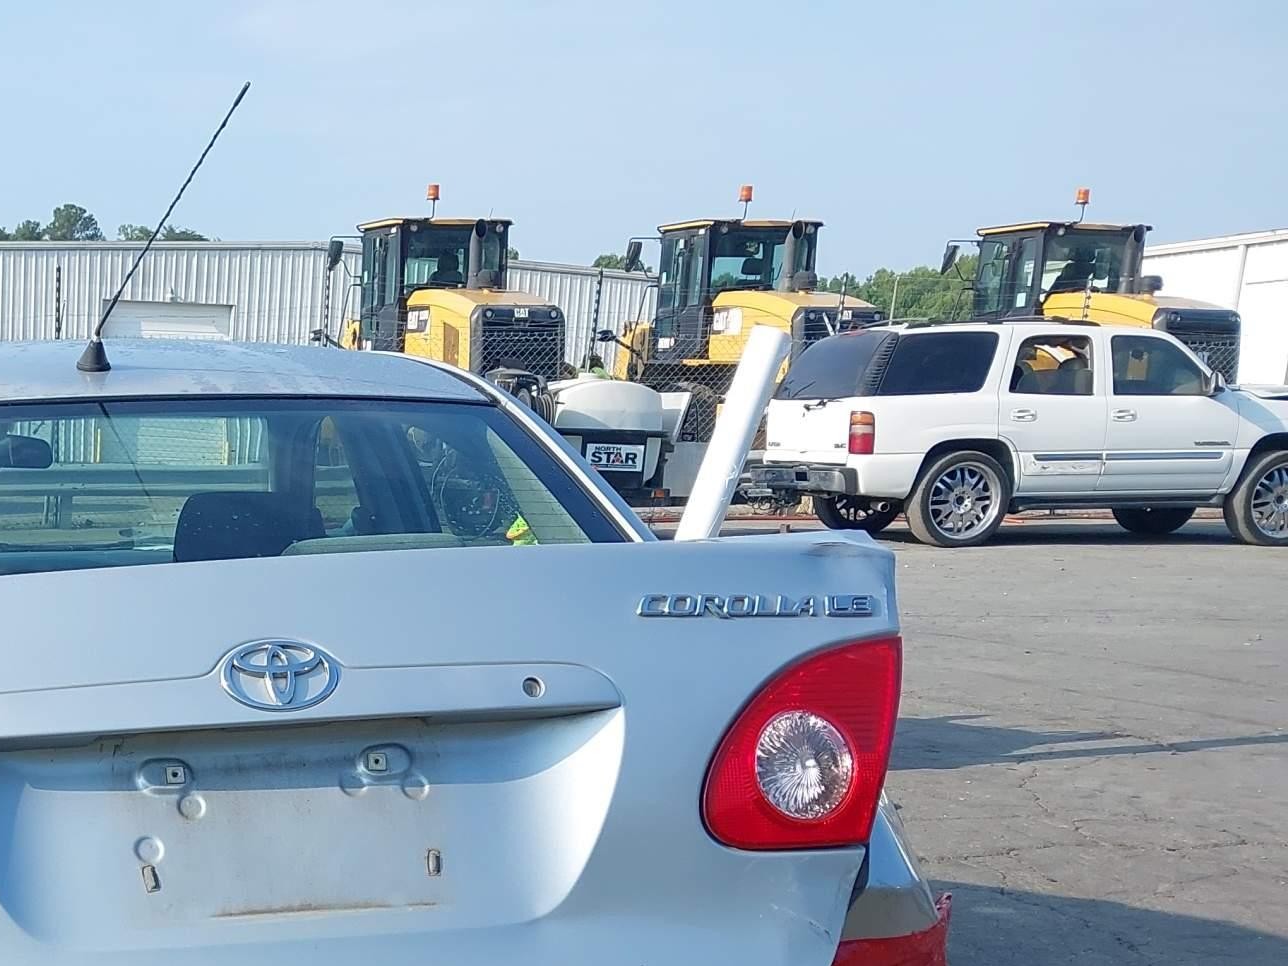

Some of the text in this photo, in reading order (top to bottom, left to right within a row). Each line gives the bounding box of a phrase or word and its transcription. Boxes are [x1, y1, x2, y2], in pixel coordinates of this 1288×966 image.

[514, 308, 529, 318] CAT
[591, 451, 638, 464] STAR
[636, 594, 874, 620] COROLLA LE
